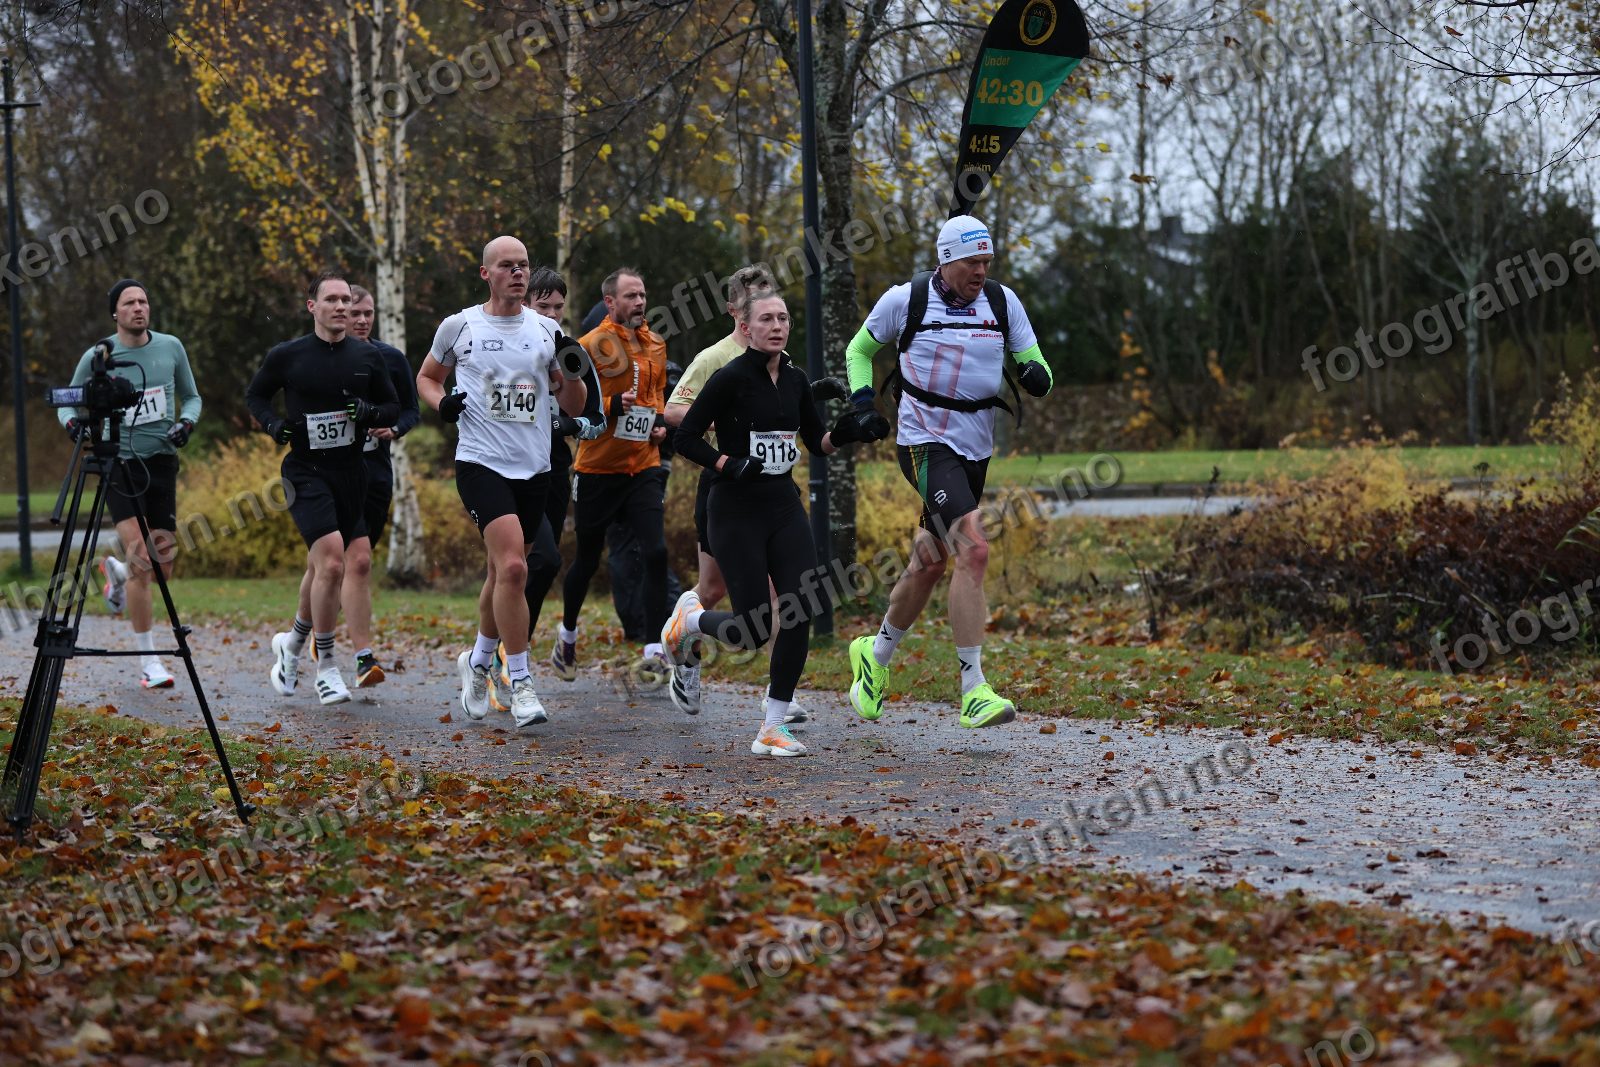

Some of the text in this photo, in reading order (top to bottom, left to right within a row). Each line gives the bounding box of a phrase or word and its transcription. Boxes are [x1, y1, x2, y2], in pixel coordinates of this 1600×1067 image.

[984, 55, 1010, 66] Under
[977, 78, 1044, 107] 42:30
[969, 134, 1000, 153] 4:15
[491, 391, 536, 412] 2140
[317, 420, 348, 440] 357
[625, 416, 649, 434] 640
[756, 442, 797, 463] 9118
